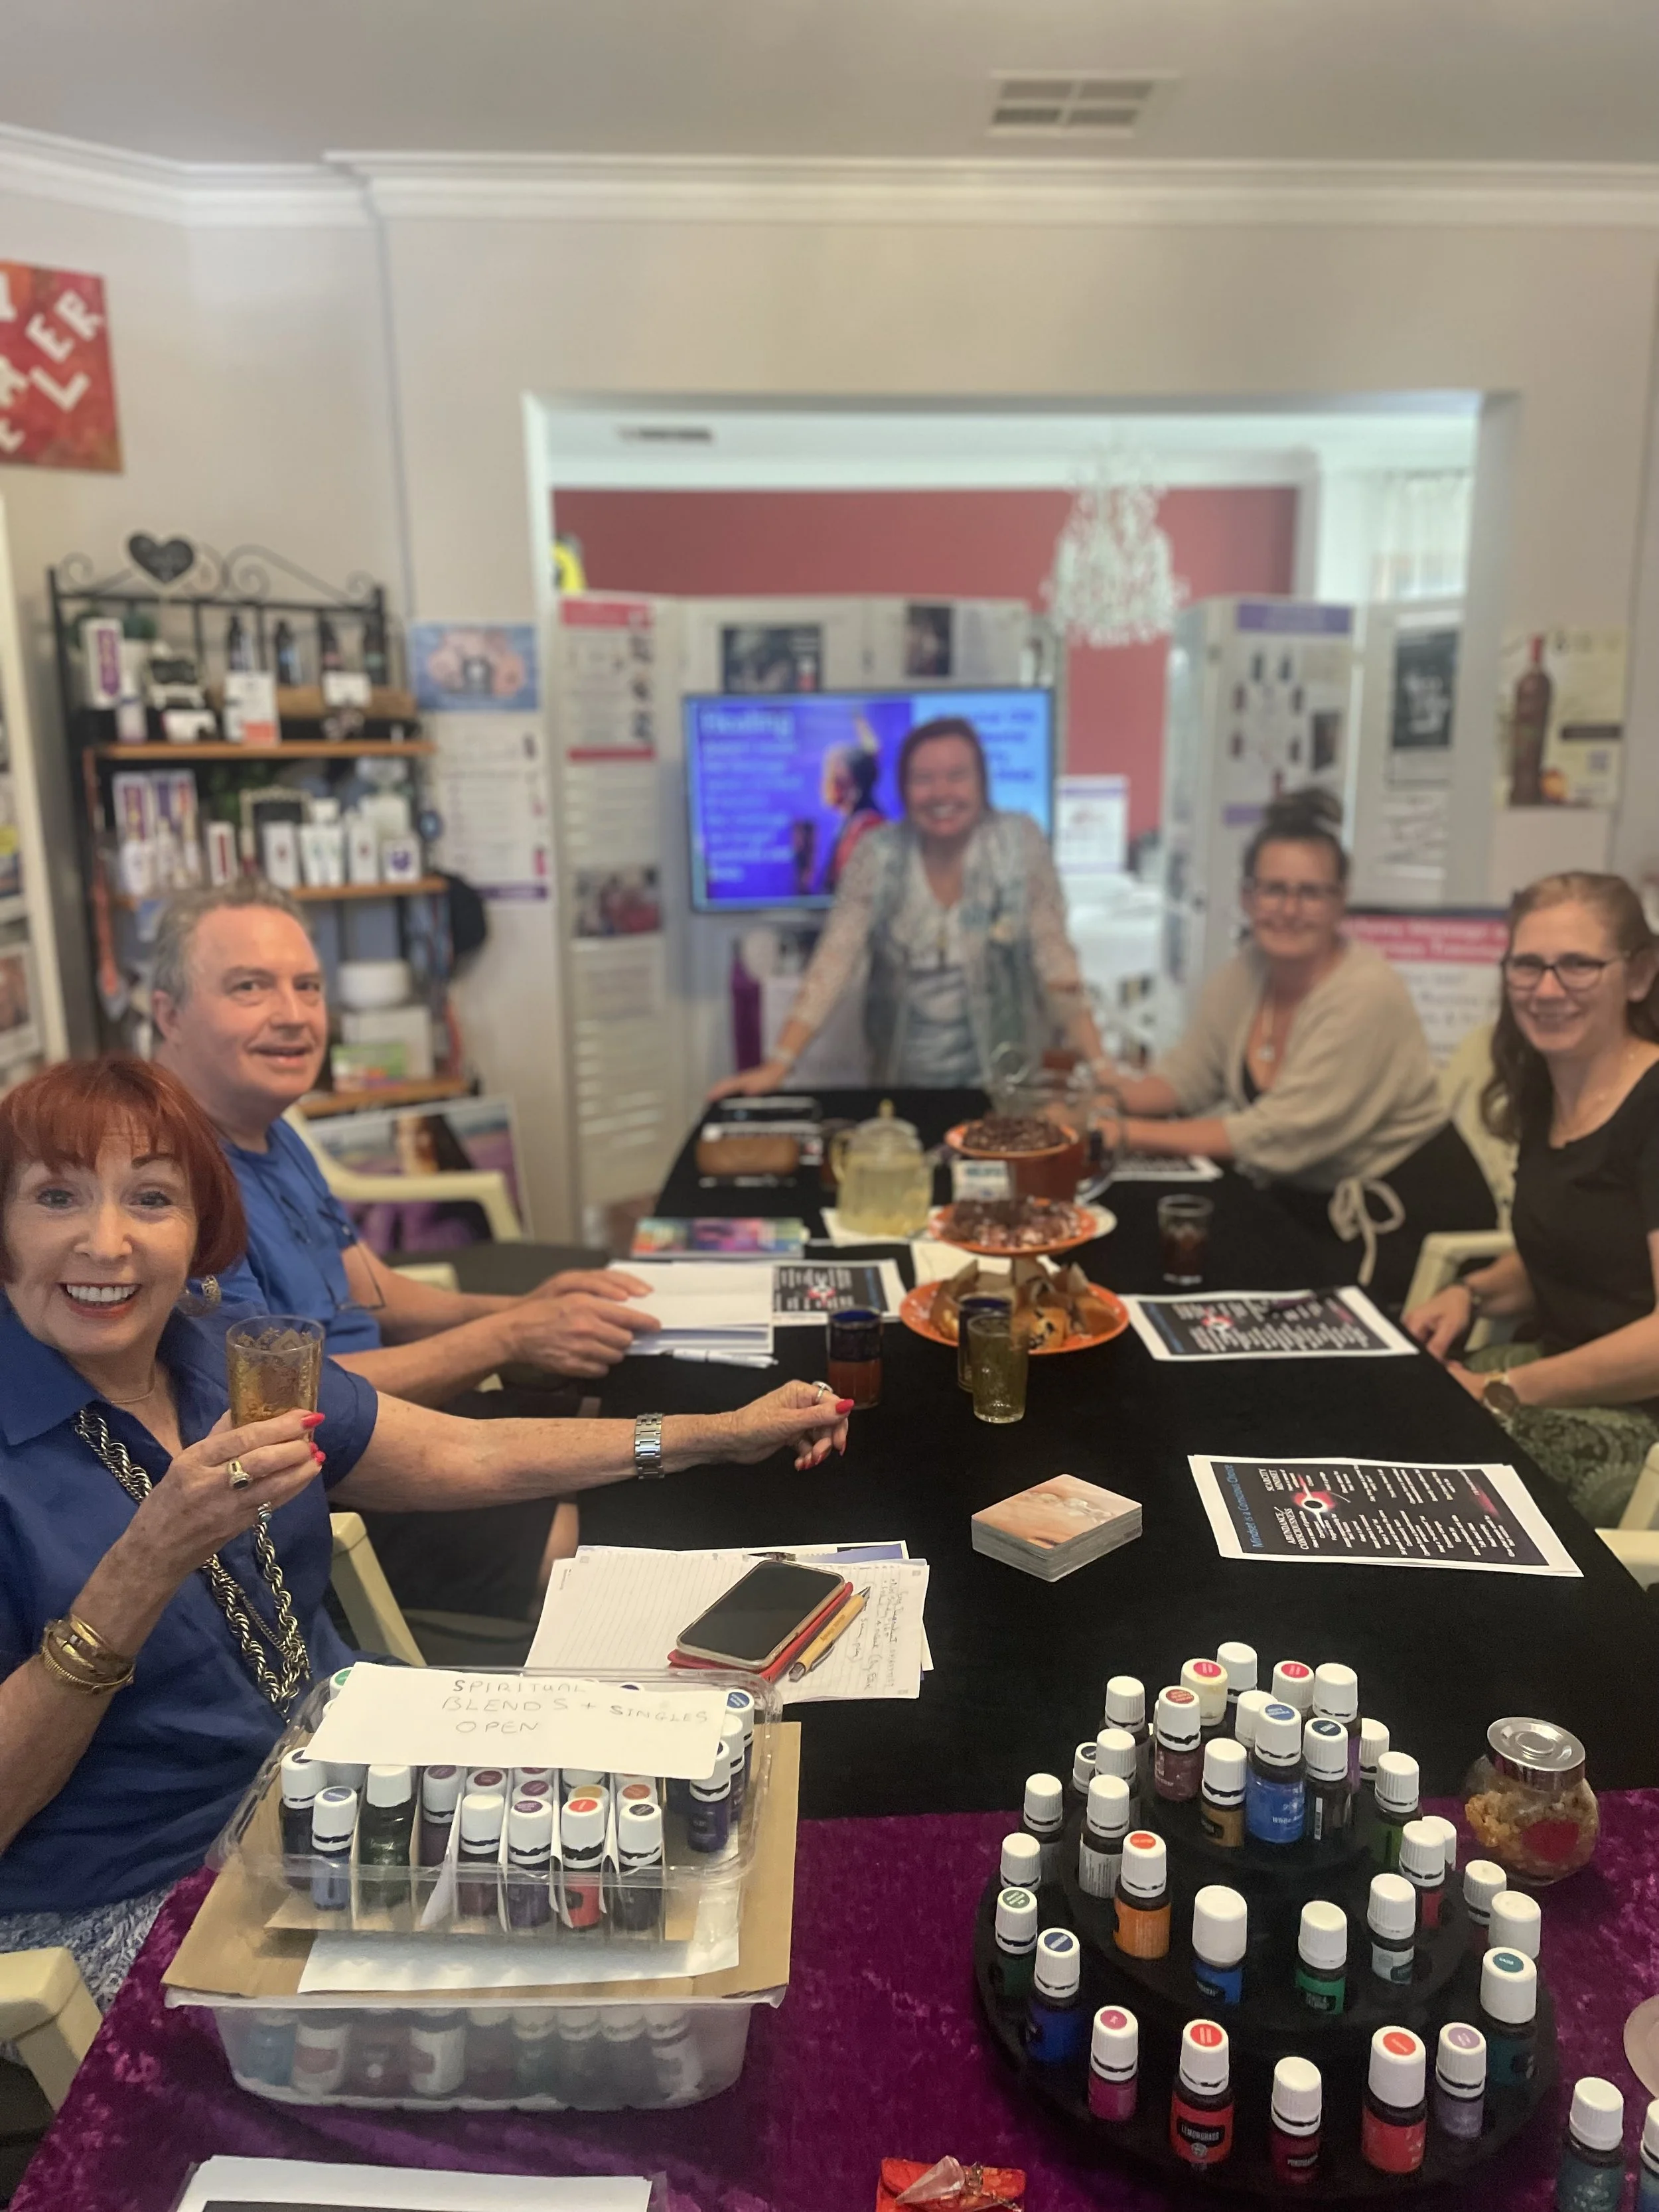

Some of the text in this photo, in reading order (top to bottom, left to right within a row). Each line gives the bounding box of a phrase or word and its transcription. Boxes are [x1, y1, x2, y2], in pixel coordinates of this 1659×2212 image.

[1258, 1468, 1275, 1491] SCARCITY
[1244, 1522, 1263, 1547] Mindset
[1284, 1508, 1309, 1550] CONSCIOUSNESS
[453, 1680, 586, 1692] SPIRITUAL
[442, 1696, 569, 1712] BLENDS
[610, 1705, 709, 1722] SINGLES
[455, 1720, 538, 1733] OPEN
[1181, 2124, 1220, 2141] LEMONGRASS
